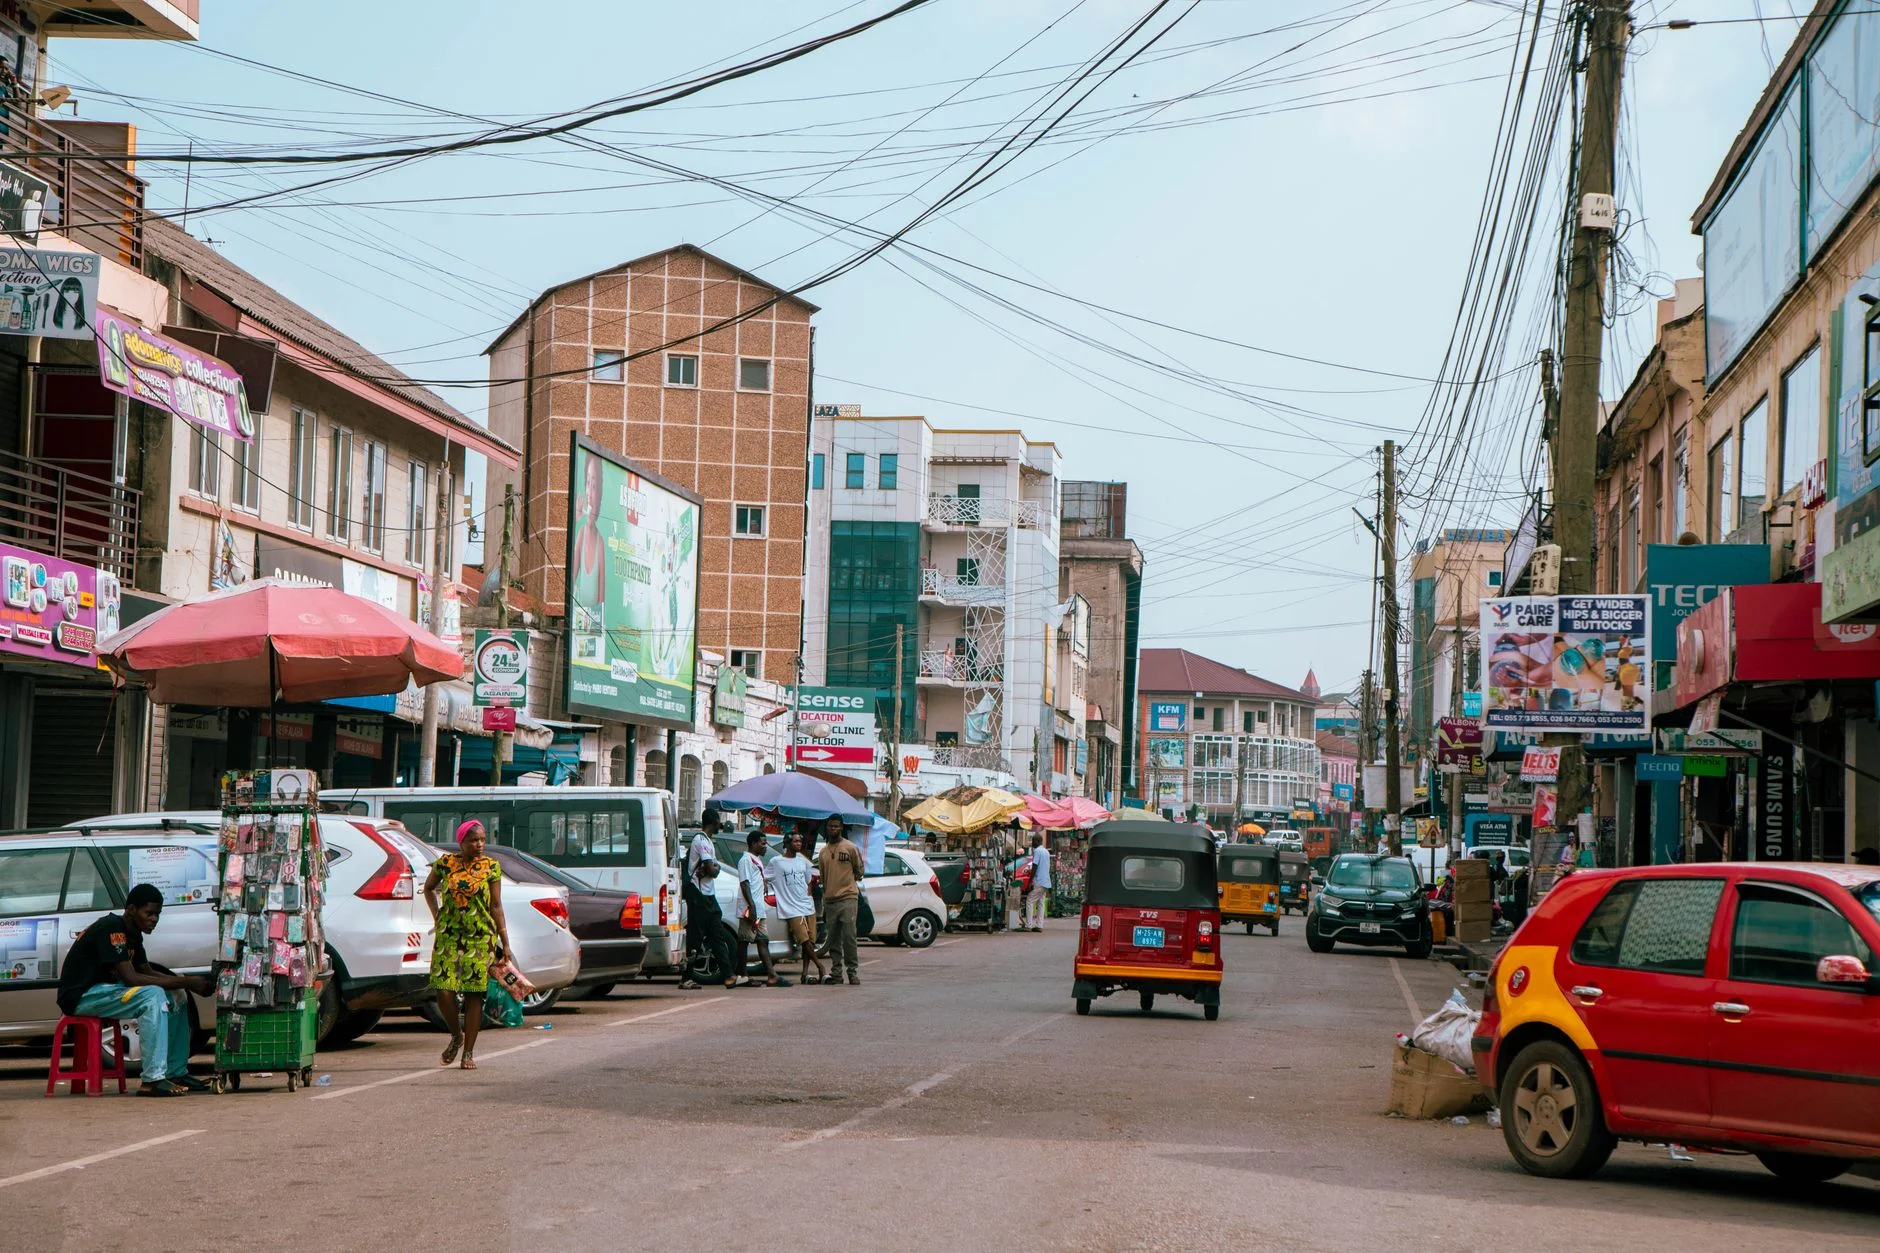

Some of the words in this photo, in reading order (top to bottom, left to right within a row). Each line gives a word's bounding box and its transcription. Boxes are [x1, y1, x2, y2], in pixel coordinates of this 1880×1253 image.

[46, 255, 94, 274] WIGS
[185, 359, 235, 396] collection
[1650, 584, 1735, 607] TEC
[1572, 599, 1593, 609] GET
[1594, 600, 1634, 609] WIDER
[1515, 604, 1555, 616] PAIRS
[1563, 611, 1589, 619] HIPS
[1591, 611, 1600, 619] &
[1601, 611, 1643, 620] BIGGER
[1517, 616, 1553, 627] CARE
[1573, 621, 1633, 631] BUTTOCKS
[492, 653, 508, 667] 24
[1158, 705, 1180, 714] KFM
[800, 712, 845, 722] OCATION
[832, 726, 865, 735] CLINIC
[797, 737, 809, 745] ST
[812, 737, 845, 746] FLOOR
[1524, 753, 1559, 769] IELTS
[1642, 762, 1680, 772] TECNO
[1765, 755, 1784, 857] SAMSUNG
[1139, 911, 1159, 919] TVS
